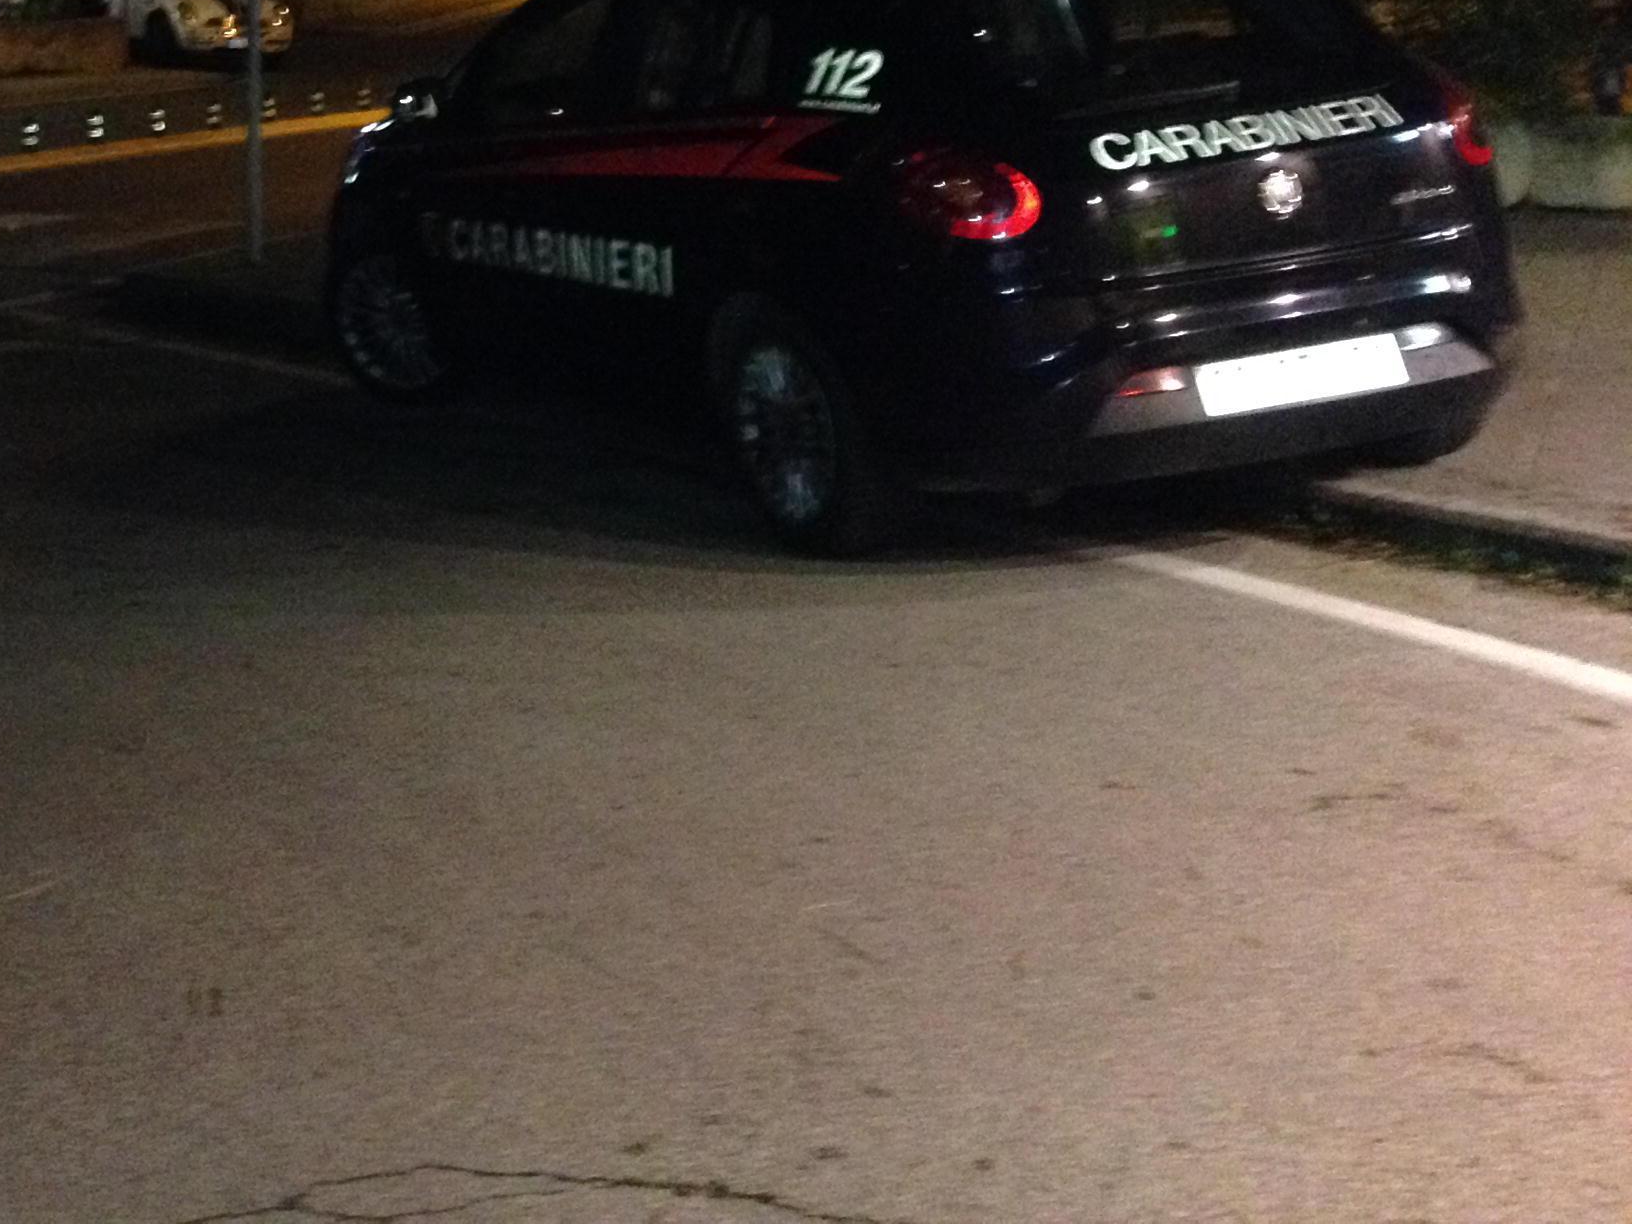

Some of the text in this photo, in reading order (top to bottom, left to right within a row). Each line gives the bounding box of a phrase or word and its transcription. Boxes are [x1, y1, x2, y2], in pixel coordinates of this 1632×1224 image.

[802, 47, 885, 99] 112
[1089, 93, 1404, 170] CARABINIERI
[448, 217, 674, 297] CARABINIERI
